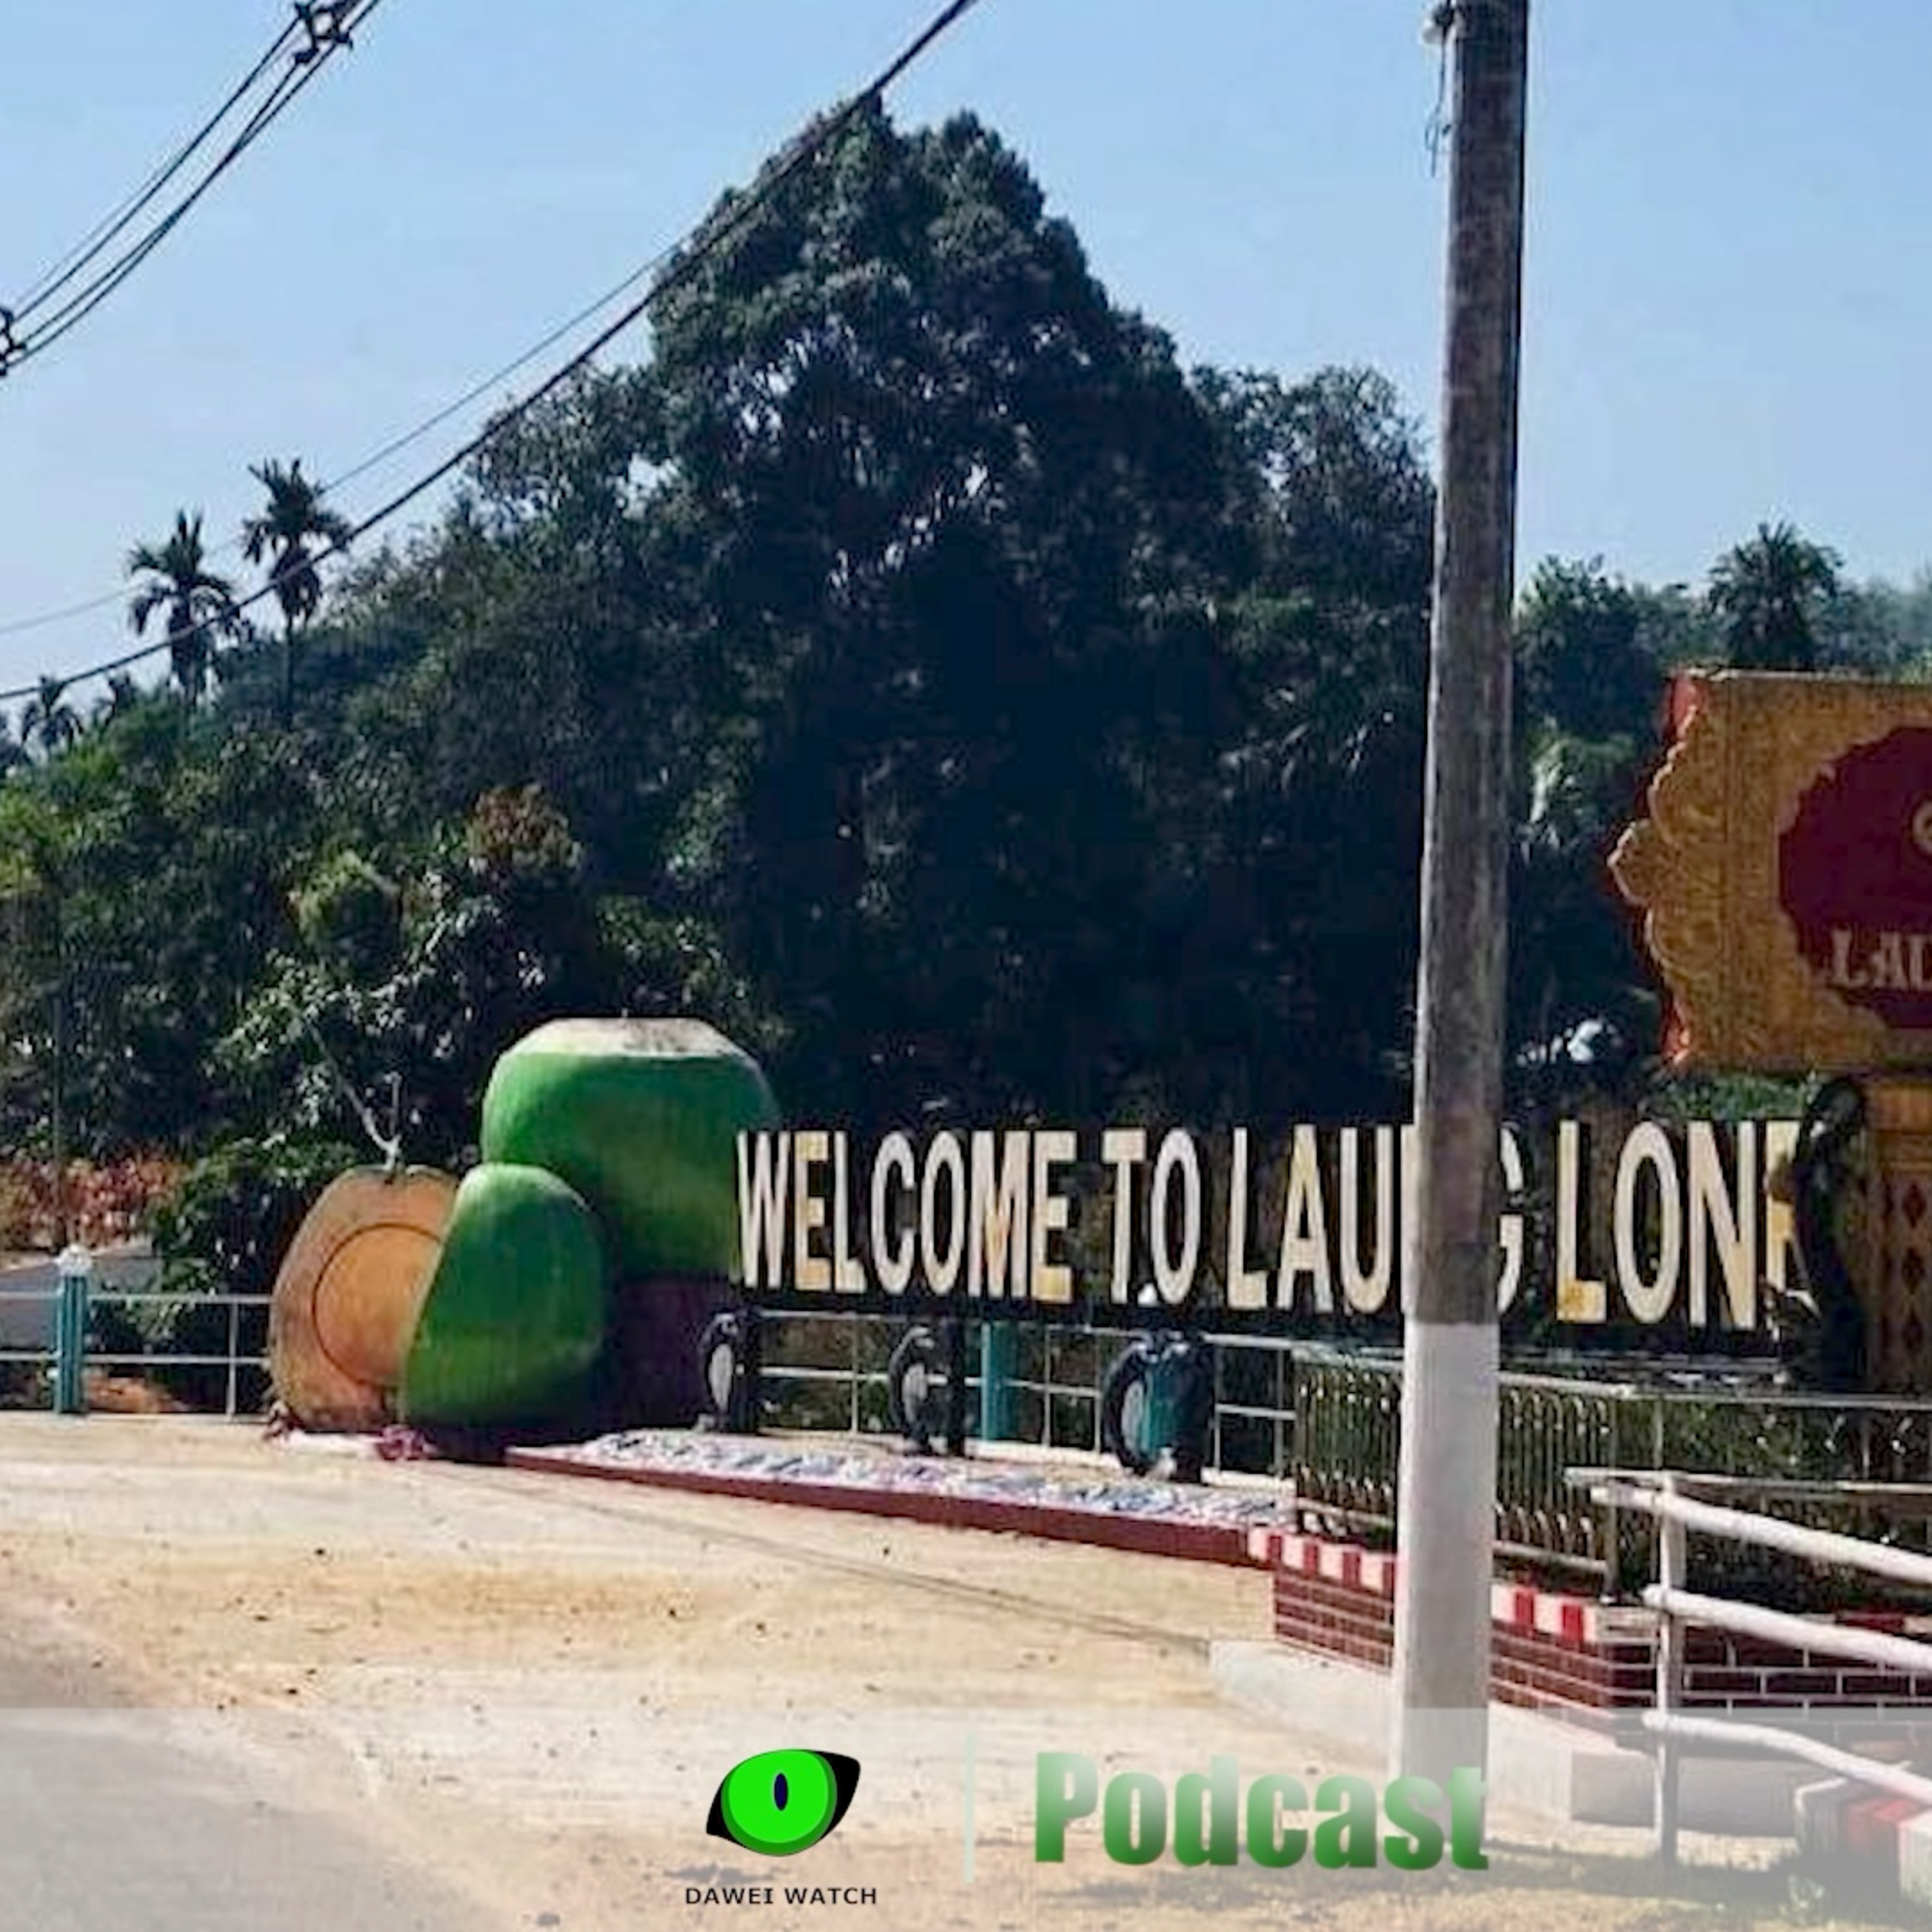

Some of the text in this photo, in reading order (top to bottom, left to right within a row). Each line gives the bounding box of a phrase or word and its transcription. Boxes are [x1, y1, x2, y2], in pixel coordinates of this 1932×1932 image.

[737, 1130, 1077, 1303] WELCOME
[1101, 1128, 1201, 1305] TO
[1226, 1122, 1524, 1315] LAU
